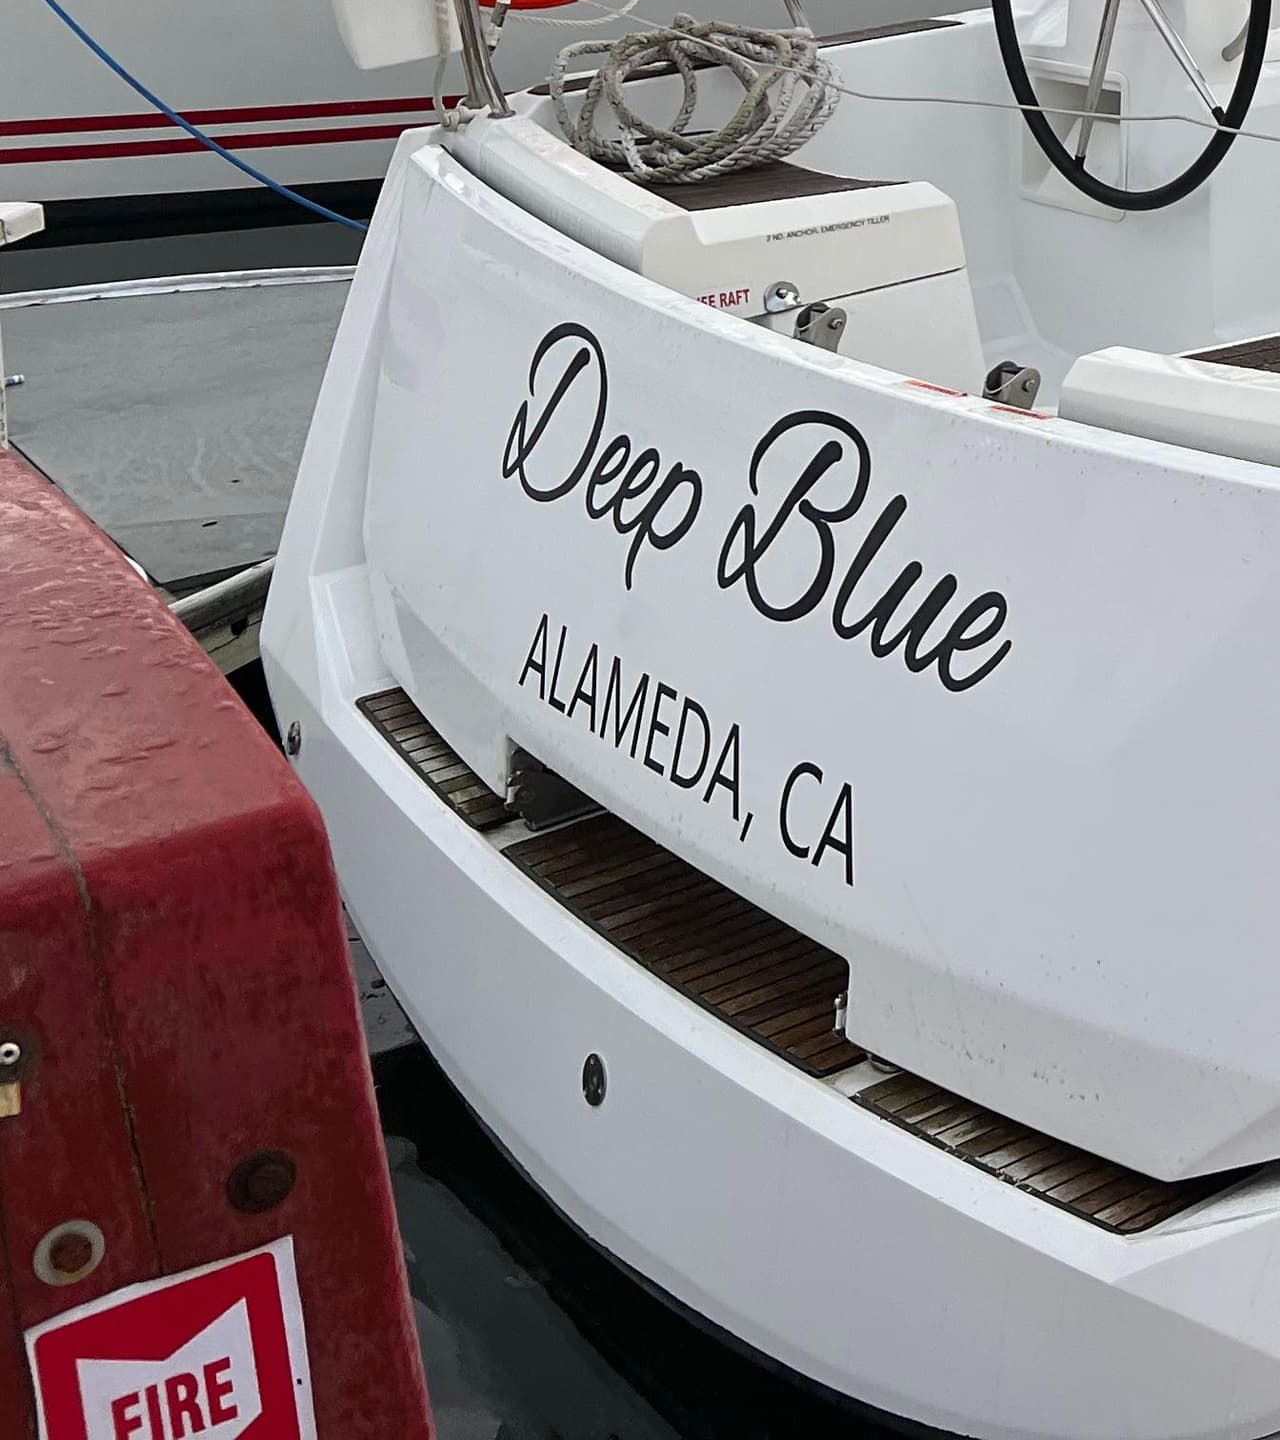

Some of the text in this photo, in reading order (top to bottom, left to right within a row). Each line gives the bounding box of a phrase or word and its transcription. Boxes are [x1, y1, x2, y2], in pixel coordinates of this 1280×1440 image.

[820, 220, 865, 234] EMERGENCY
[867, 215, 890, 225] TILLER
[719, 288, 750, 309] RAFT
[502, 321, 1013, 693] Deep Blue
[518, 613, 855, 886] ALAMEDA, CA
[111, 1356, 239, 1440] FIRE
